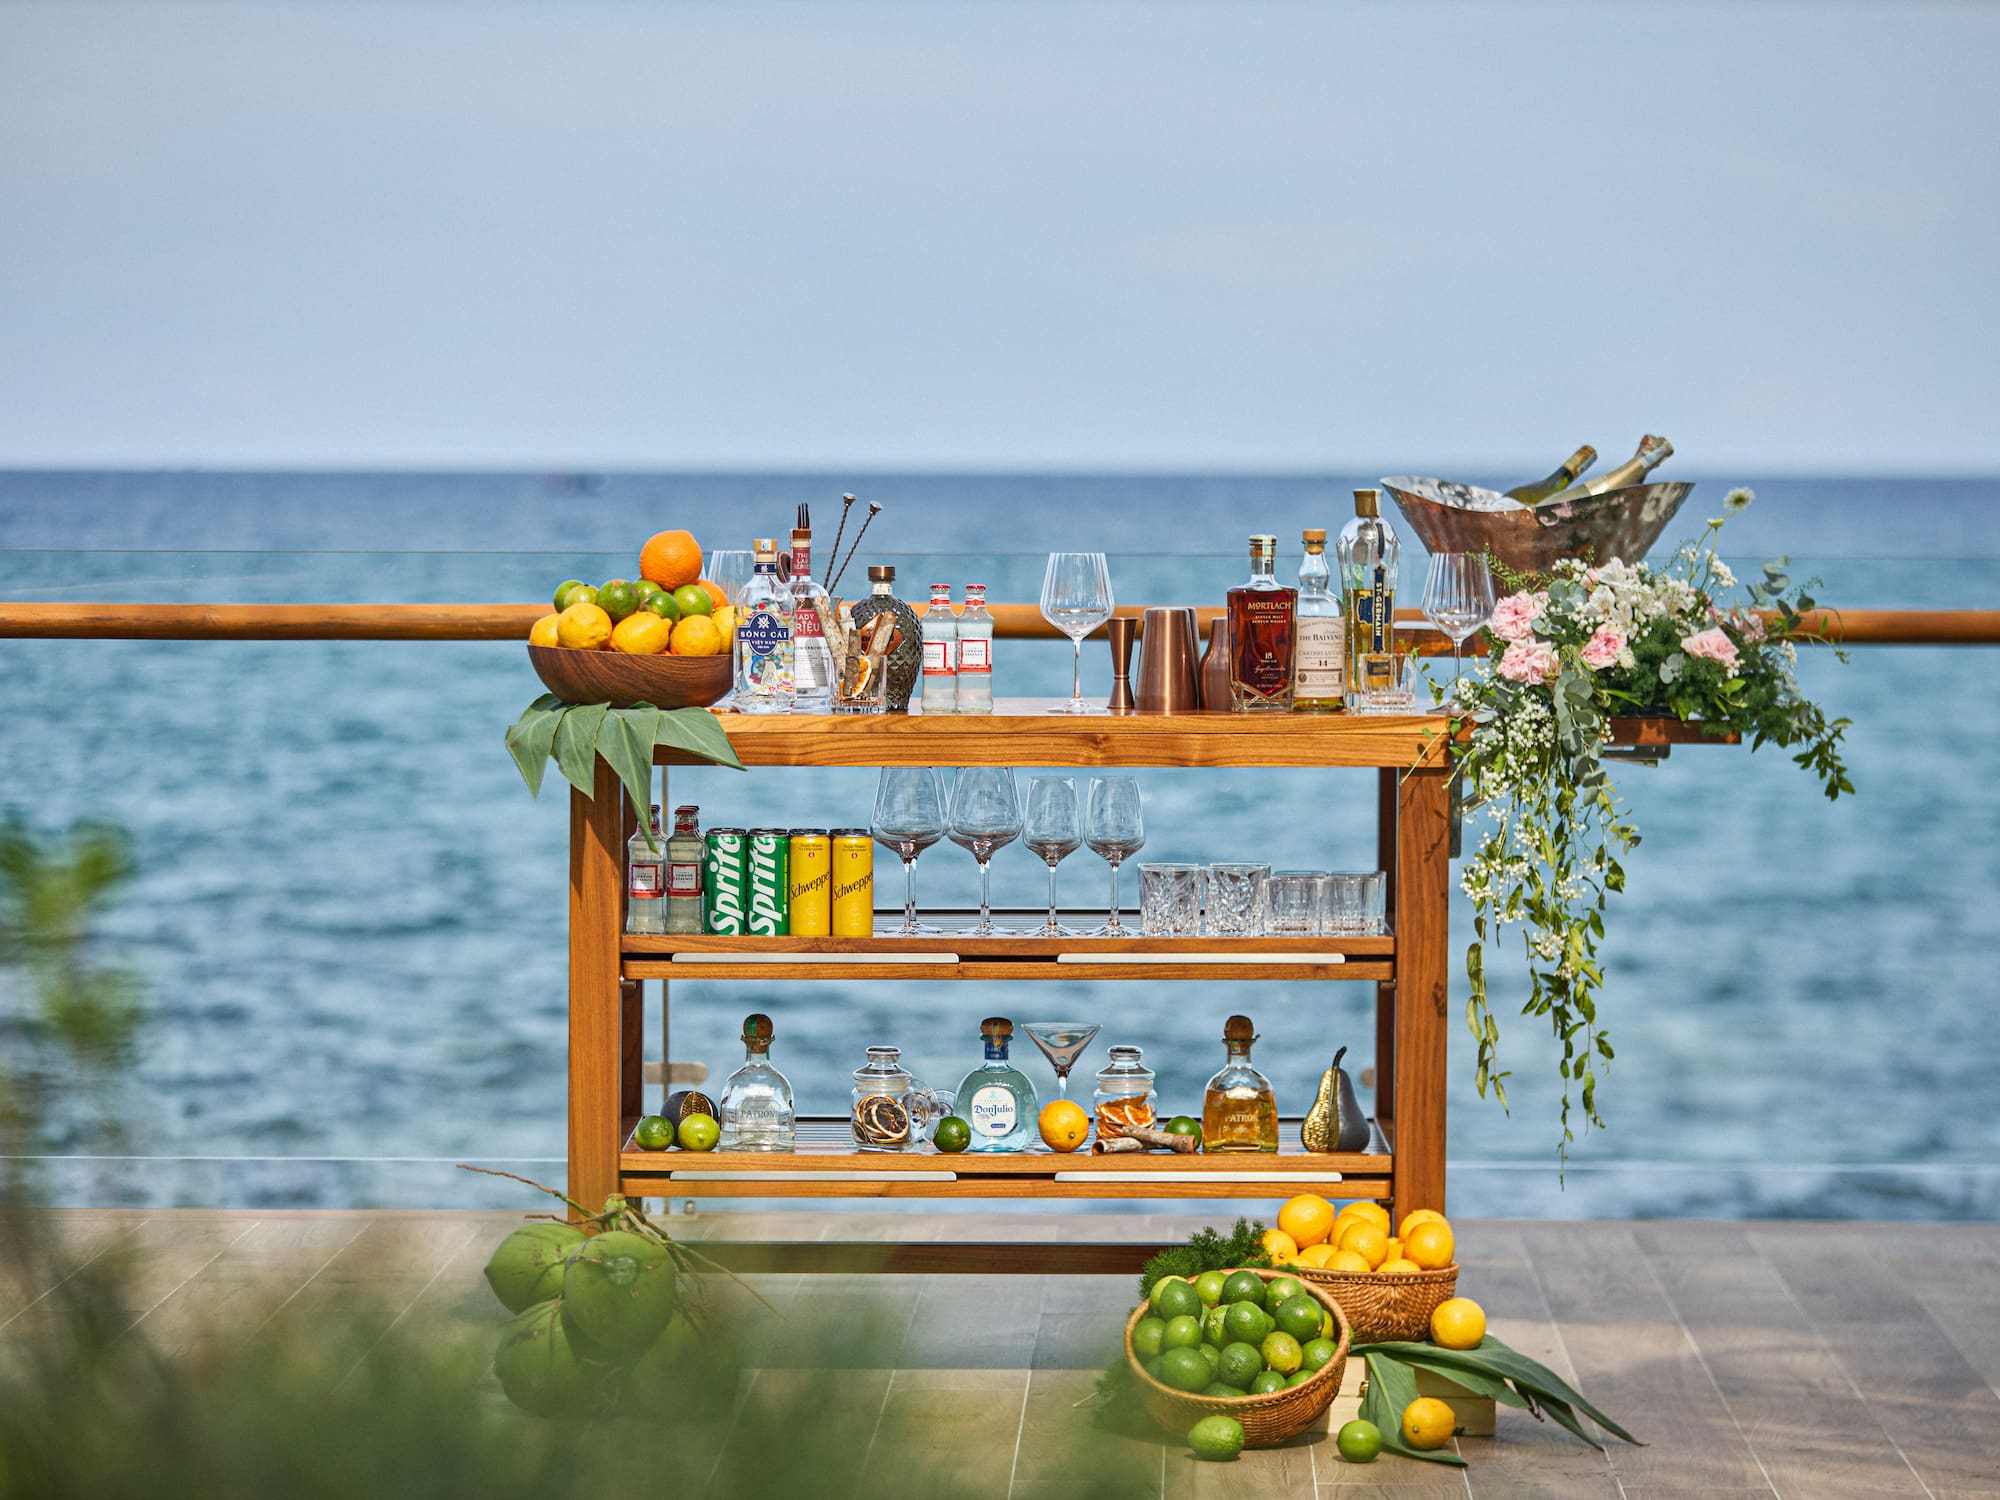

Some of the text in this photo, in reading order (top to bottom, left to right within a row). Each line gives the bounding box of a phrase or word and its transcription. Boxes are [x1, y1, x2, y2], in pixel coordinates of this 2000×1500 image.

[1248, 602, 1290, 610] MORTLACH
[709, 835, 745, 936] Sprite
[749, 836, 782, 936] Sprite
[790, 871, 831, 901] Schweppe
[834, 871, 873, 901] Schweppe
